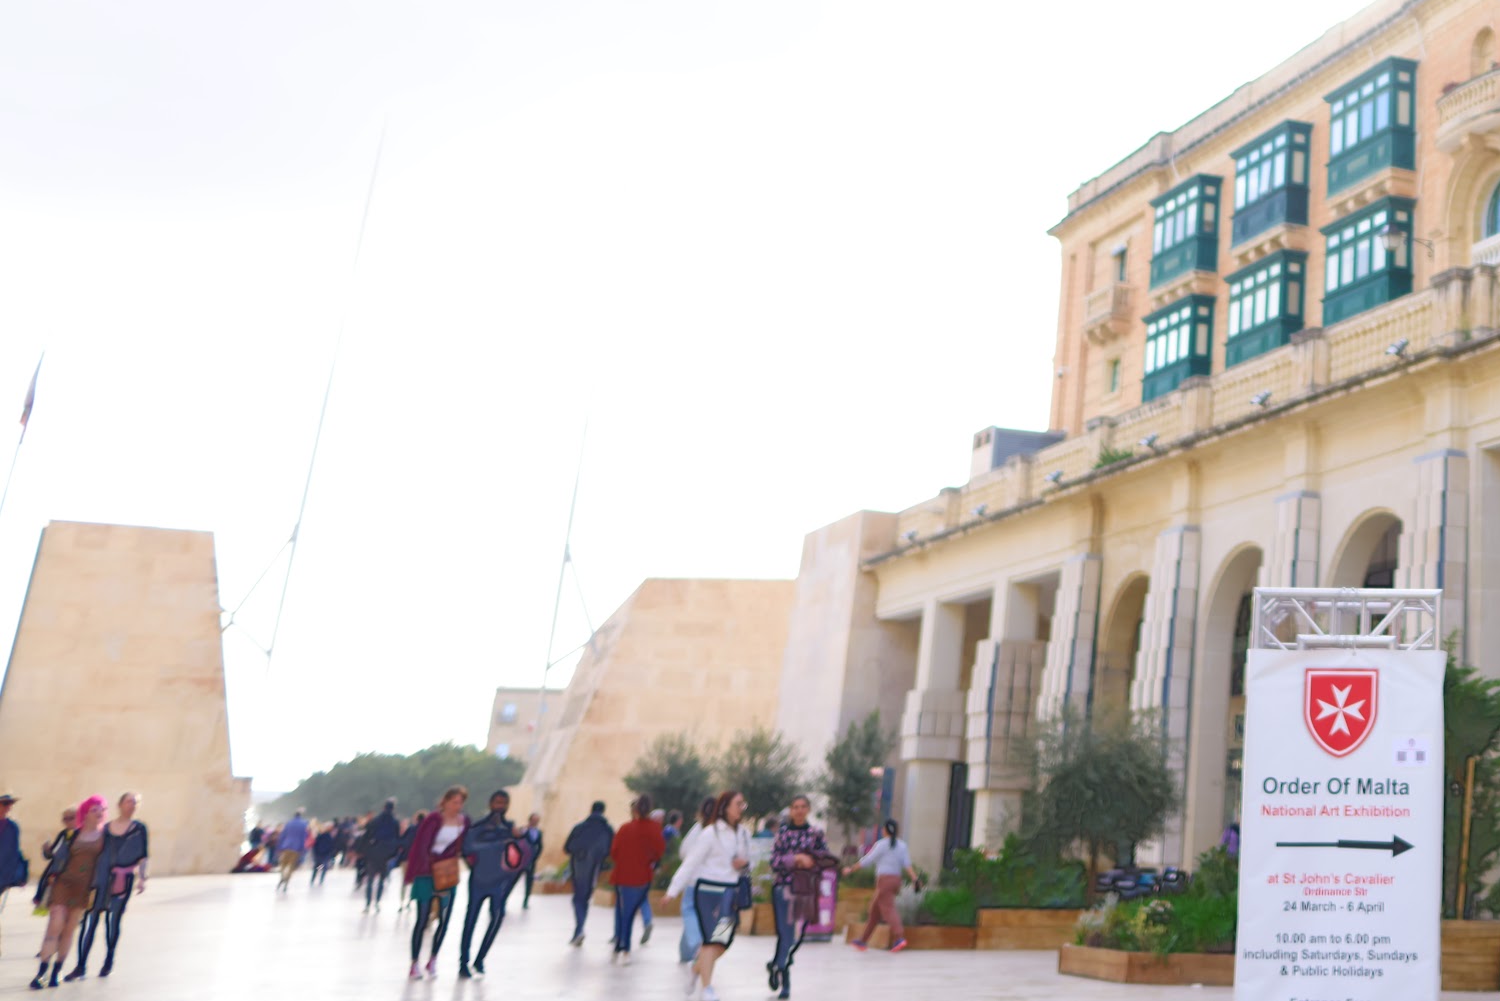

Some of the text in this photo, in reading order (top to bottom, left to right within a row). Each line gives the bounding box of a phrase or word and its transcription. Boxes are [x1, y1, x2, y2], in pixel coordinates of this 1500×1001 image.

[1263, 776, 1410, 795] Order Of Malta
[1261, 804, 1410, 817] National Art Exhibition
[1267, 873, 1395, 885] at St John's Cavalier
[1303, 887, 1368, 897] Ordinance Str
[1283, 901, 1297, 912] 24
[1301, 901, 1336, 912] March
[1347, 902, 1354, 912] 6
[1358, 901, 1385, 914] April
[1275, 933, 1391, 946] 10.00 am to 6.00 pm
[1243, 950, 1418, 962] including Saturdays, Sundays
[1280, 966, 1383, 979] & Public Holidays
